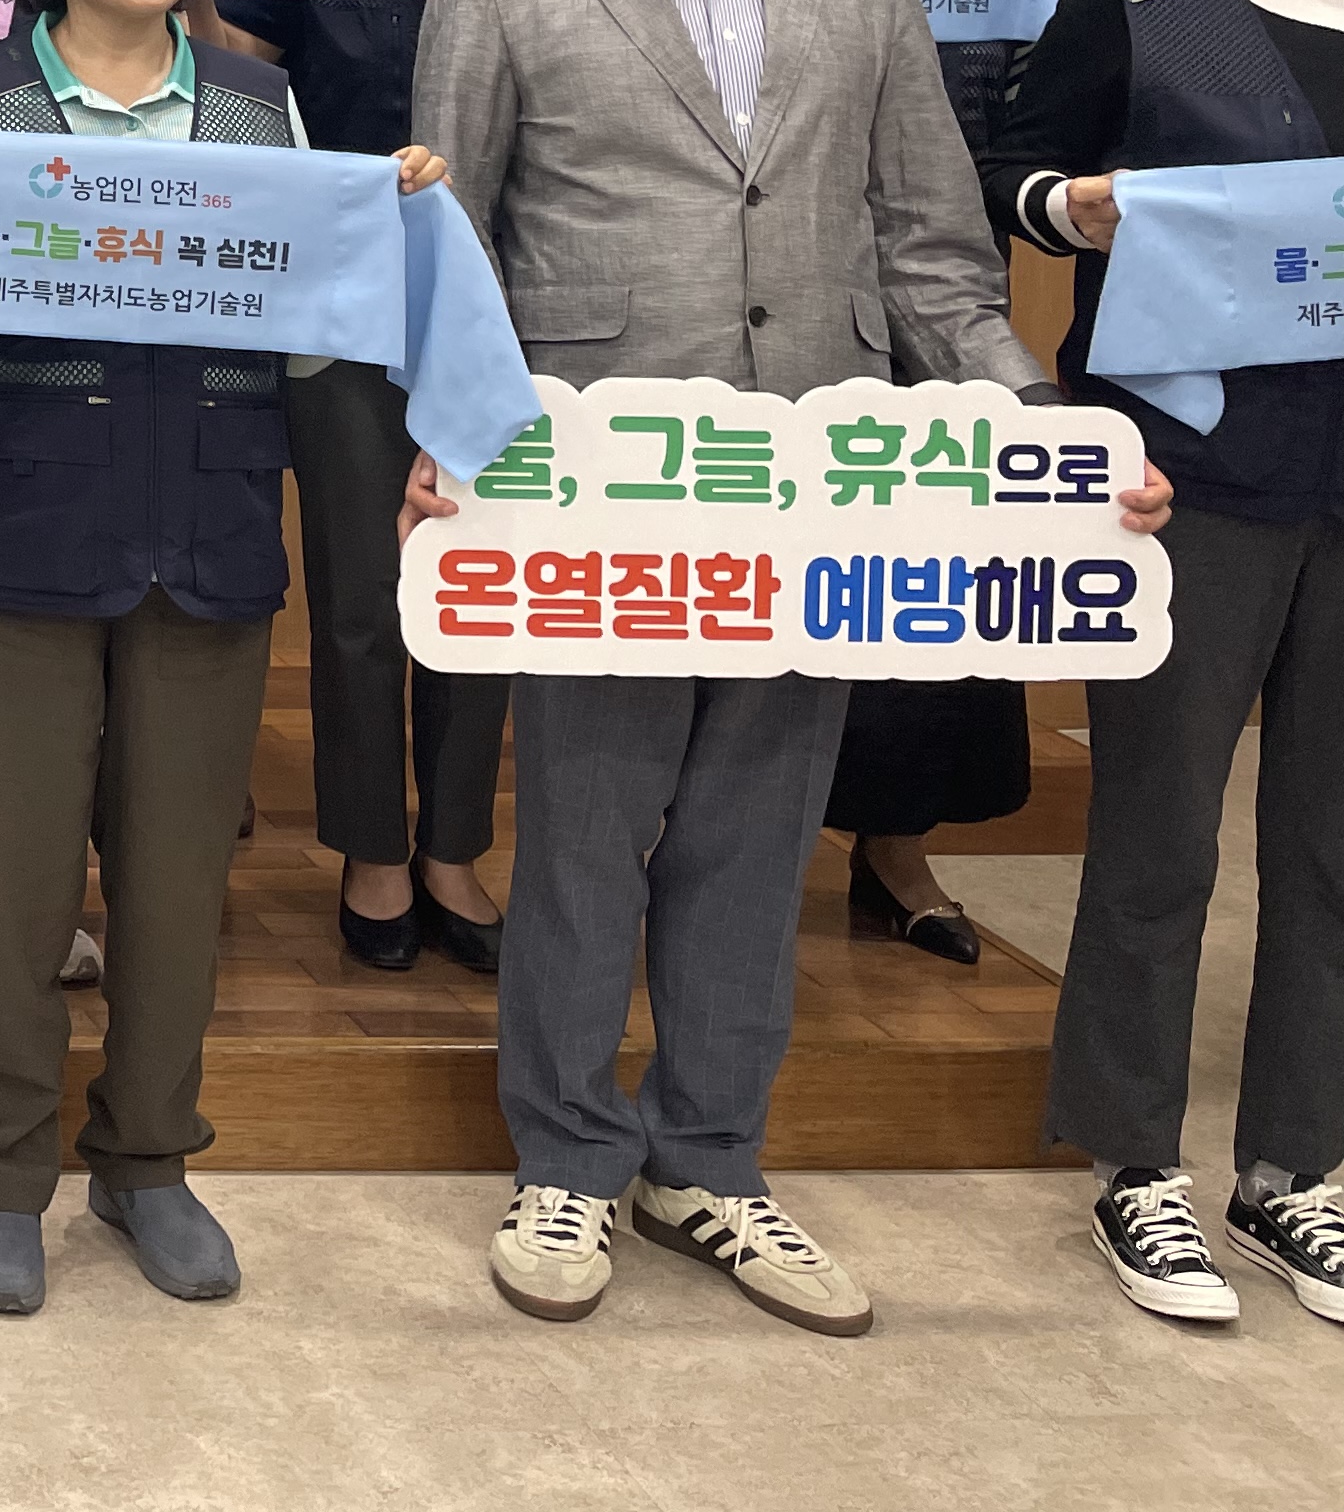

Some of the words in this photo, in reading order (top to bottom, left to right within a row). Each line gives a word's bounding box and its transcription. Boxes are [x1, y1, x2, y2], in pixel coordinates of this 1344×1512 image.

[70, 175, 141, 204] 농업인
[177, 234, 207, 268] 꼭
[216, 237, 290, 272] 실천!
[605, 416, 796, 511] 그늘,
[824, 416, 1110, 507] 휴식으로
[436, 550, 780, 641] 온열질환
[804, 555, 1138, 644] 예방해요
